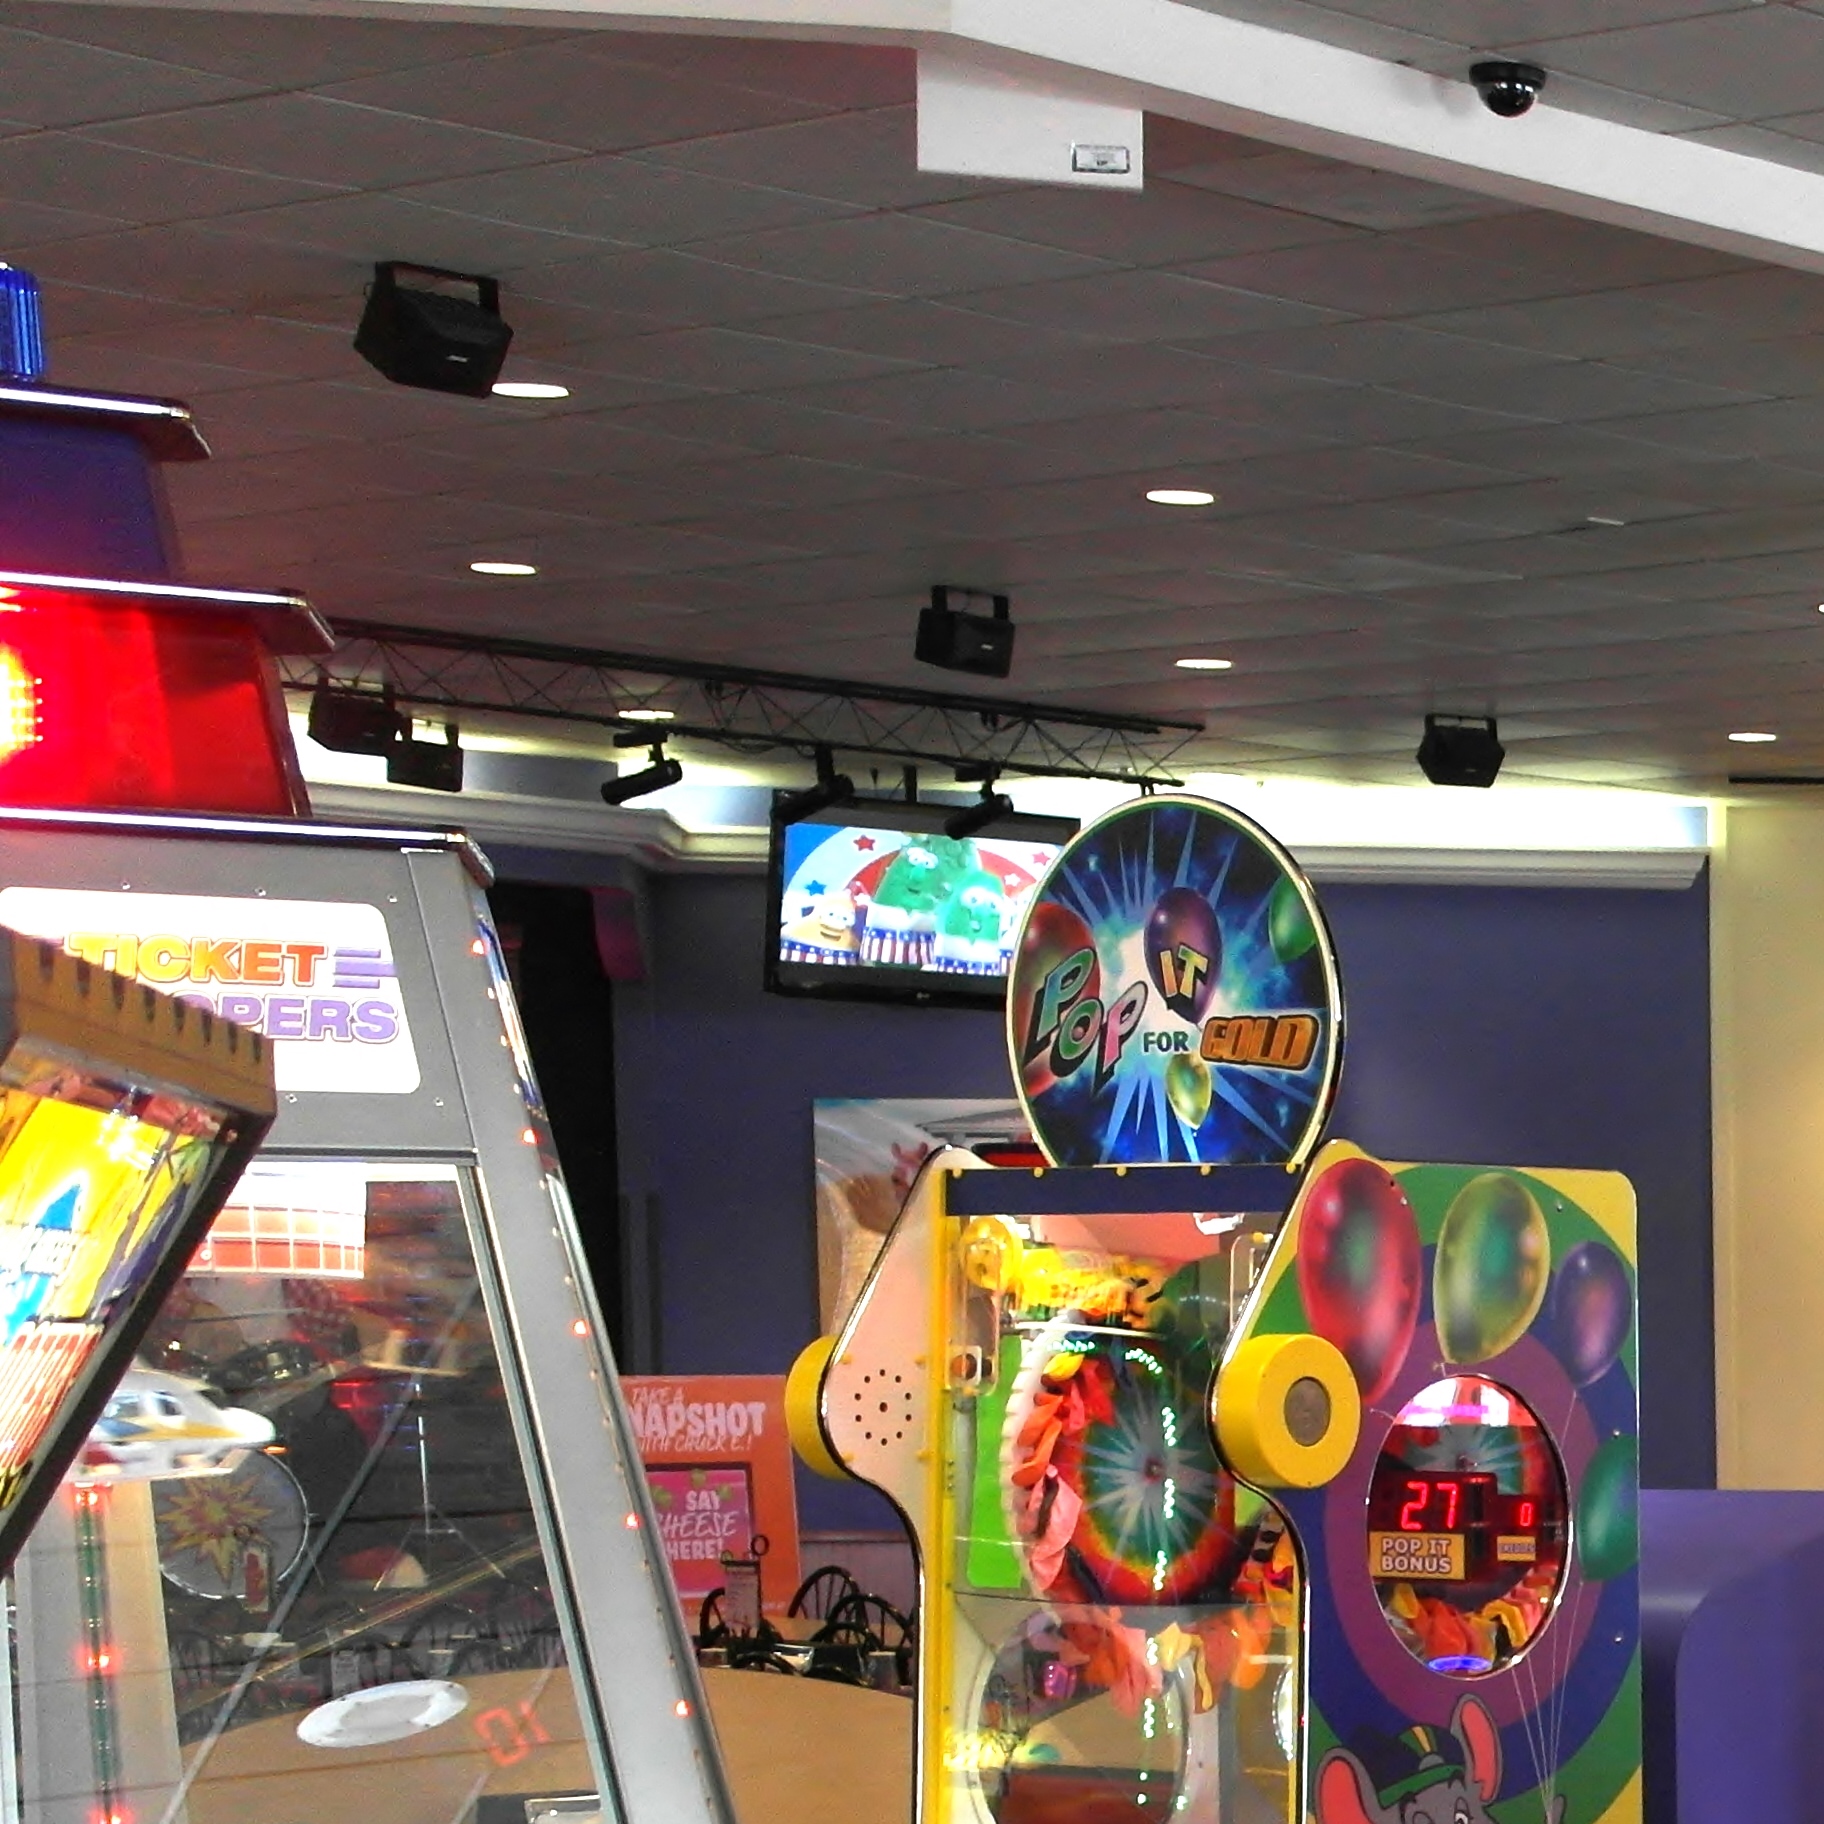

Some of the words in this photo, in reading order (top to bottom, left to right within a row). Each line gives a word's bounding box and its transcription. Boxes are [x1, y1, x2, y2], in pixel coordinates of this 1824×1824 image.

[67, 931, 329, 988] TICKET
[1159, 943, 1209, 1003] IT
[1030, 947, 1149, 1082] POP
[1143, 1031, 1189, 1053] FOR
[1200, 1014, 1319, 1072] GOLD
[632, 1387, 671, 1402] TAKE
[674, 1387, 685, 1401] A
[628, 1401, 767, 1437] NAPSHOT
[640, 1436, 669, 1451] ITH
[674, 1435, 725, 1452] CHUCK
[686, 1490, 721, 1511] SAY
[1401, 1481, 1459, 1530] 27
[1519, 1503, 1533, 1527] 0
[1381, 1537, 1422, 1555] POP
[1429, 1538, 1450, 1556] IT
[1381, 1555, 1451, 1574] BONUS
